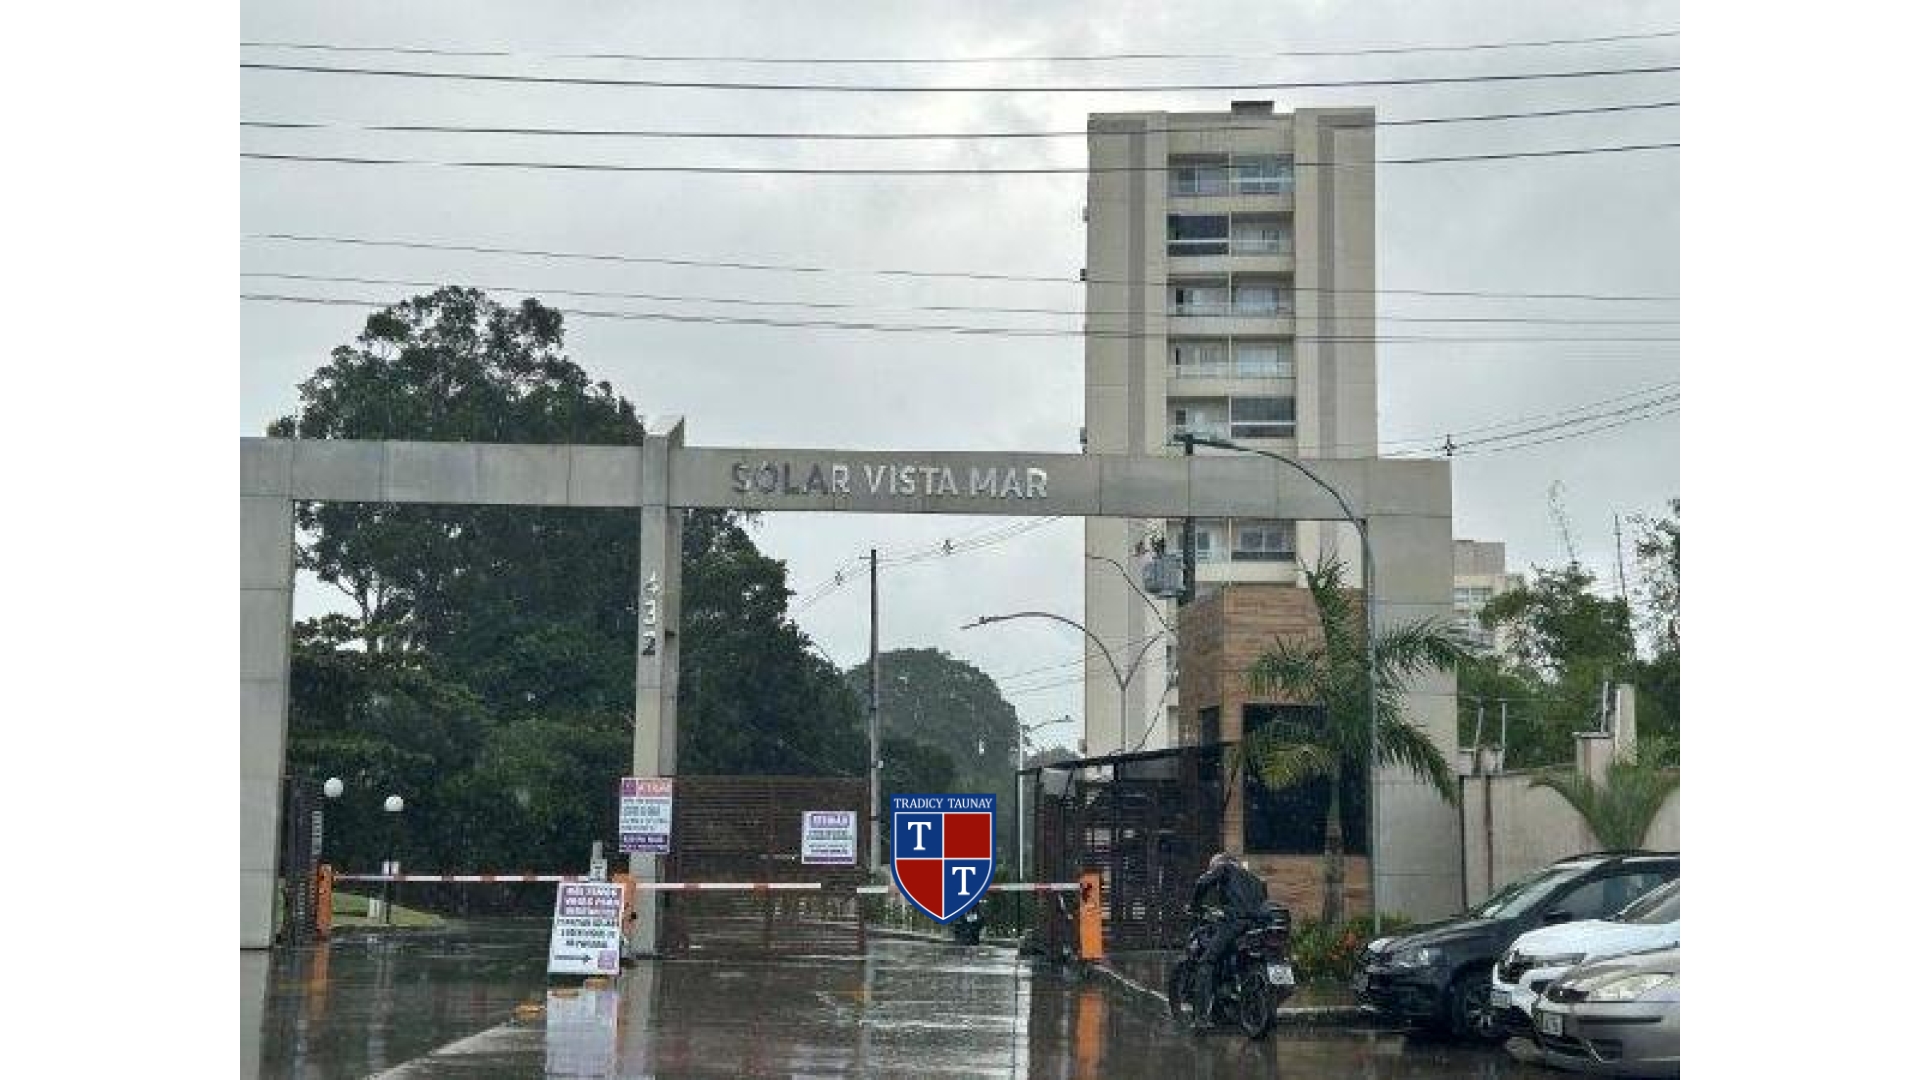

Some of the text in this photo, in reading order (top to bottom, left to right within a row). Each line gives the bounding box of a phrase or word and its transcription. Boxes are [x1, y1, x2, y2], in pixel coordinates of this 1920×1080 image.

[731, 462, 1048, 499] SOLAR VISTA MAR
[642, 570, 659, 656] 432
